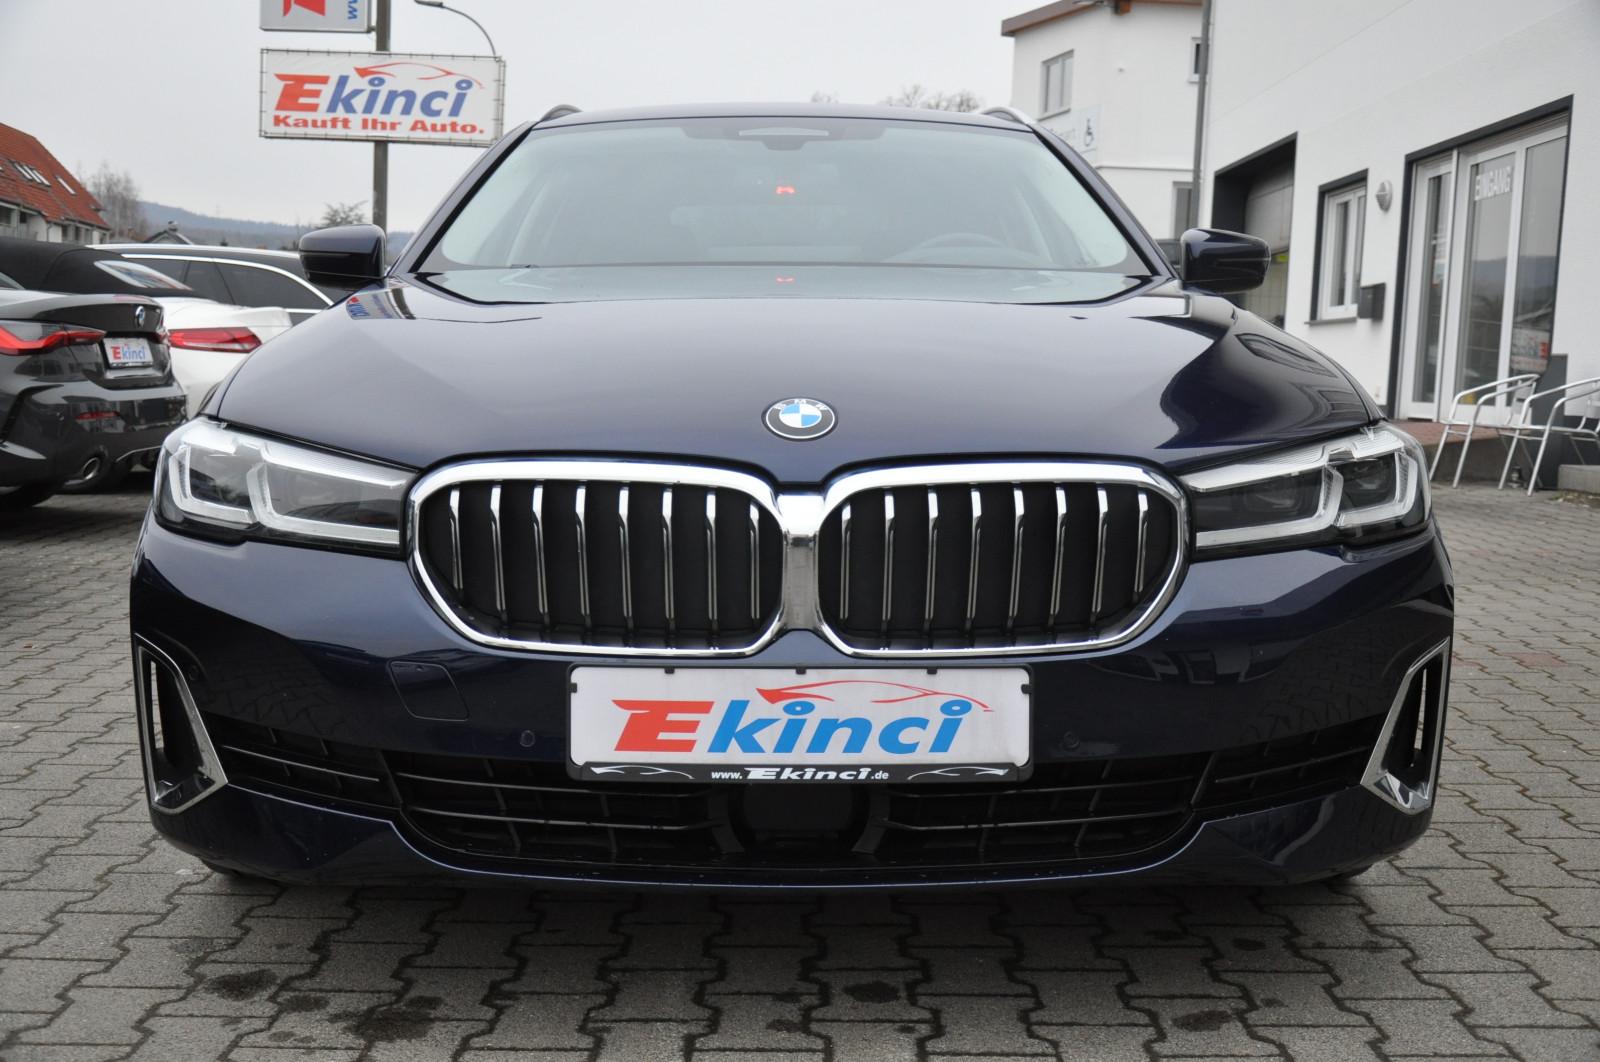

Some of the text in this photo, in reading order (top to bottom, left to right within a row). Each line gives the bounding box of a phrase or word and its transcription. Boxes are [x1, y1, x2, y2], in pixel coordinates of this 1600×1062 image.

[274, 73, 473, 117] Ekinci
[273, 115, 485, 134] Kauft Ihr Auto.
[1475, 166, 1511, 200] EINGANG
[611, 699, 973, 755] Ekinci
[711, 767, 889, 780] www.Ekinci.de
